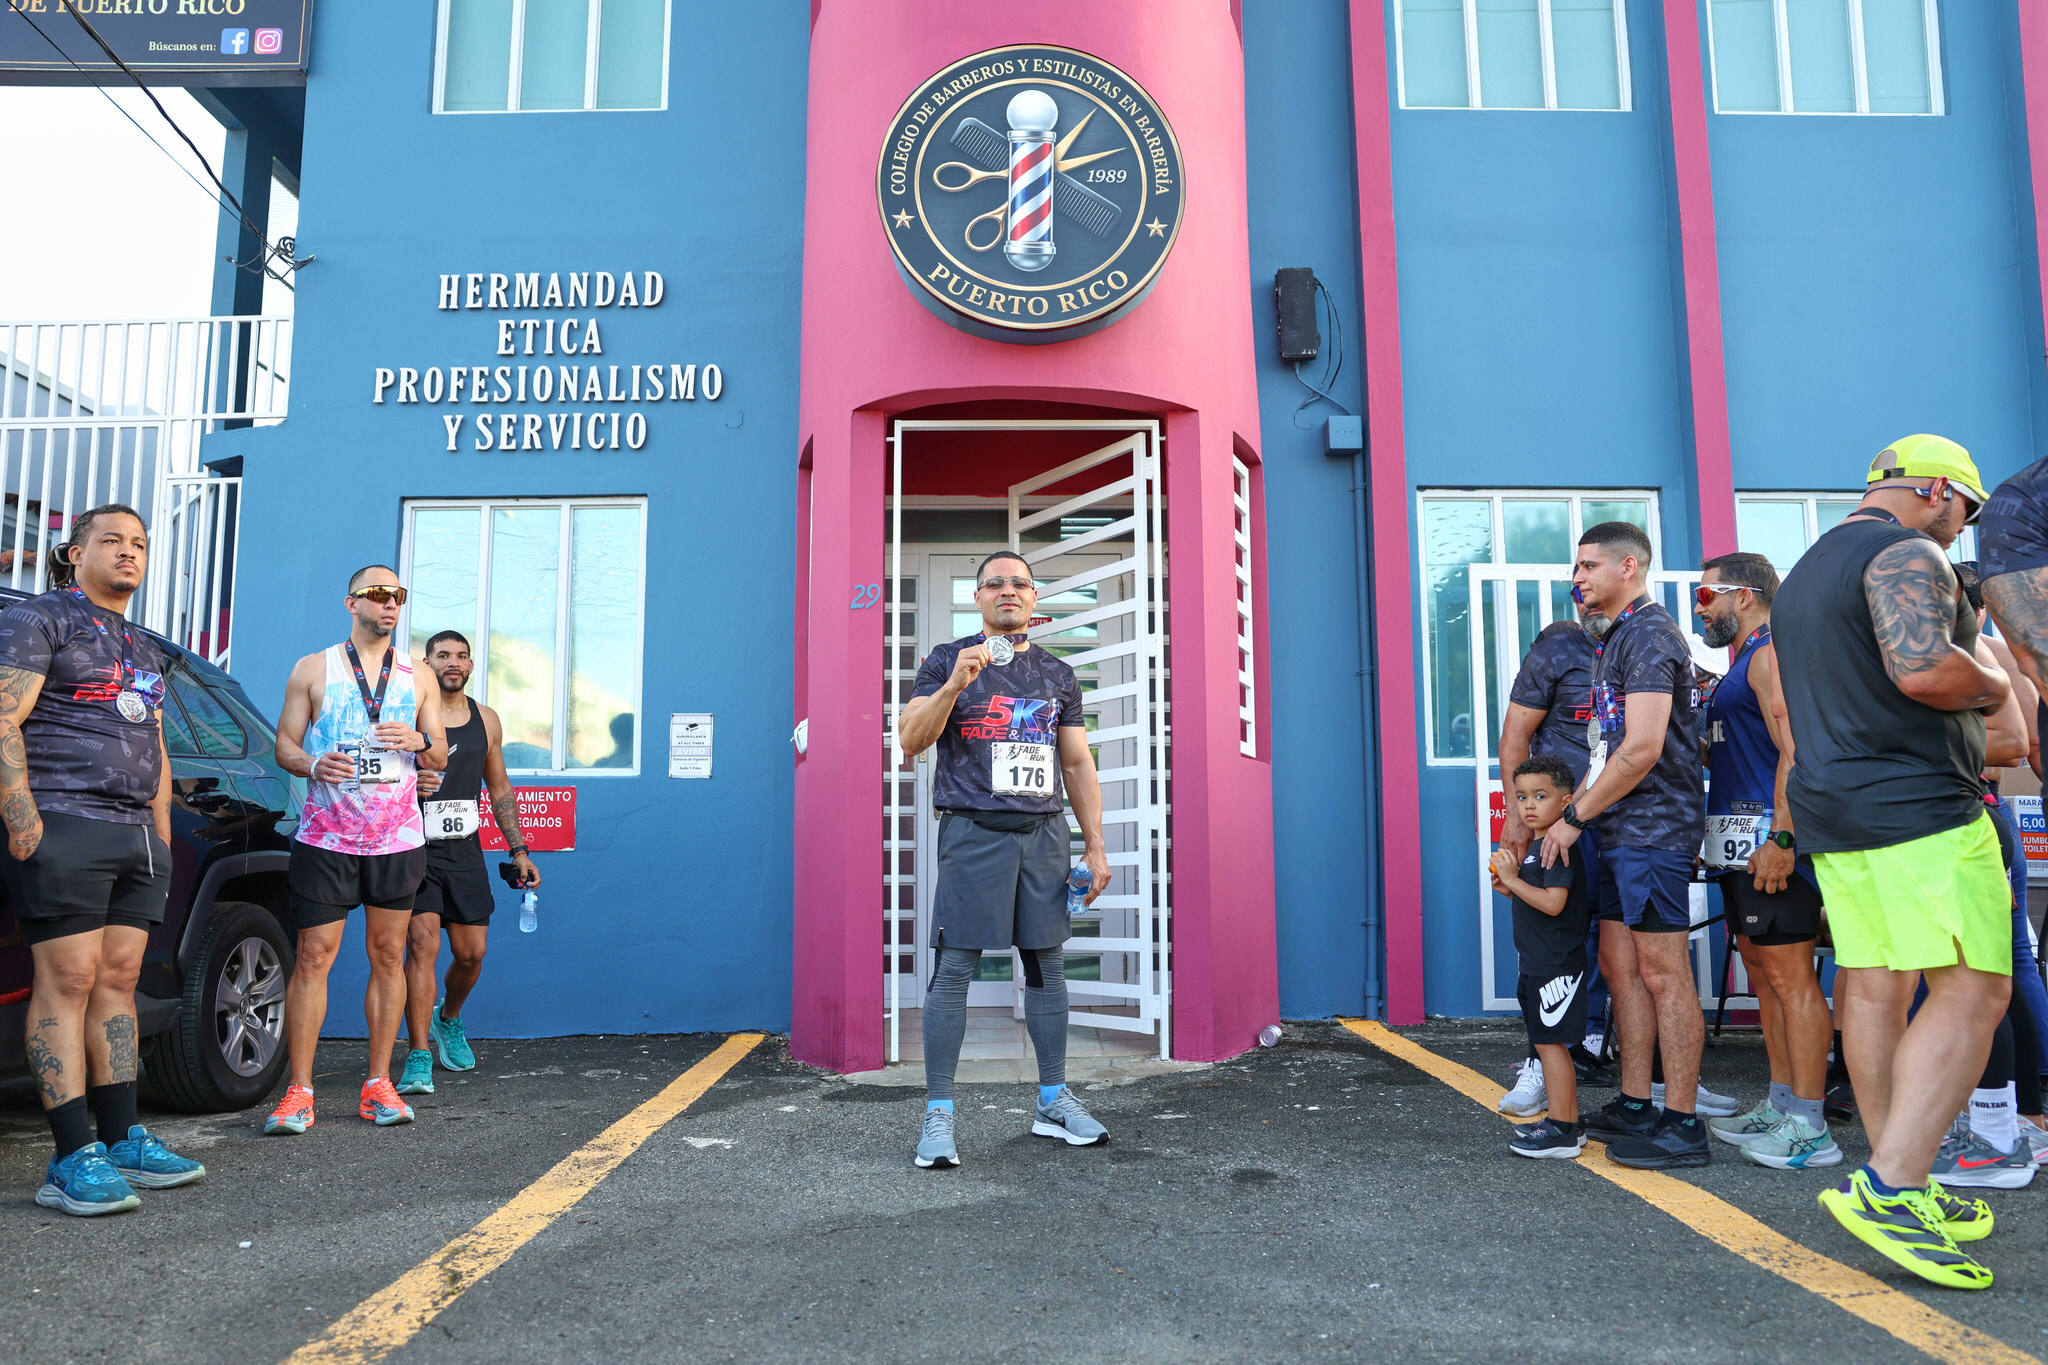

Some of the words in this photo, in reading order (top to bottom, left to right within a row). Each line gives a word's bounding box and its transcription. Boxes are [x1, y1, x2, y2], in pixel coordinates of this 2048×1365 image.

[8, 0, 47, 13] DE
[55, 0, 168, 14] PUERTO
[176, 0, 245, 15] RICO
[148, 41, 198, 51] Búscanos
[200, 43, 217, 51] en:
[890, 124, 920, 195] COLEGIO
[914, 100, 937, 125] DE
[931, 59, 1014, 108] BARBEROS
[1017, 59, 1030, 72] Y
[1033, 58, 1122, 99] ESTILISTAS
[1117, 93, 1142, 117] EN
[1135, 115, 1173, 195] BARBERÍA
[1086, 169, 1127, 184] 1989
[438, 271, 665, 309] HERMANDAD
[927, 262, 1049, 316] PUERTO
[1057, 270, 1129, 313] RICO
[496, 318, 602, 355] ETICA
[373, 363, 723, 403] PROFESIONALISMO
[442, 414, 464, 451] Y
[475, 412, 648, 451] SERVICIO
[850, 584, 881, 609] 29
[980, 695, 1049, 731] 5K
[961, 726, 1009, 740] FADE
[1008, 730, 1020, 741] &
[1019, 745, 1041, 754] FADE
[1029, 754, 1046, 762] RUN
[1009, 766, 1045, 788] 176
[479, 803, 548, 814] EXSIVO
[442, 817, 464, 832] 86
[1728, 818, 1753, 826] FADE
[489, 836, 503, 845] LEY
[1724, 839, 1752, 861] 92
[1539, 975, 1576, 1010] NIKE
